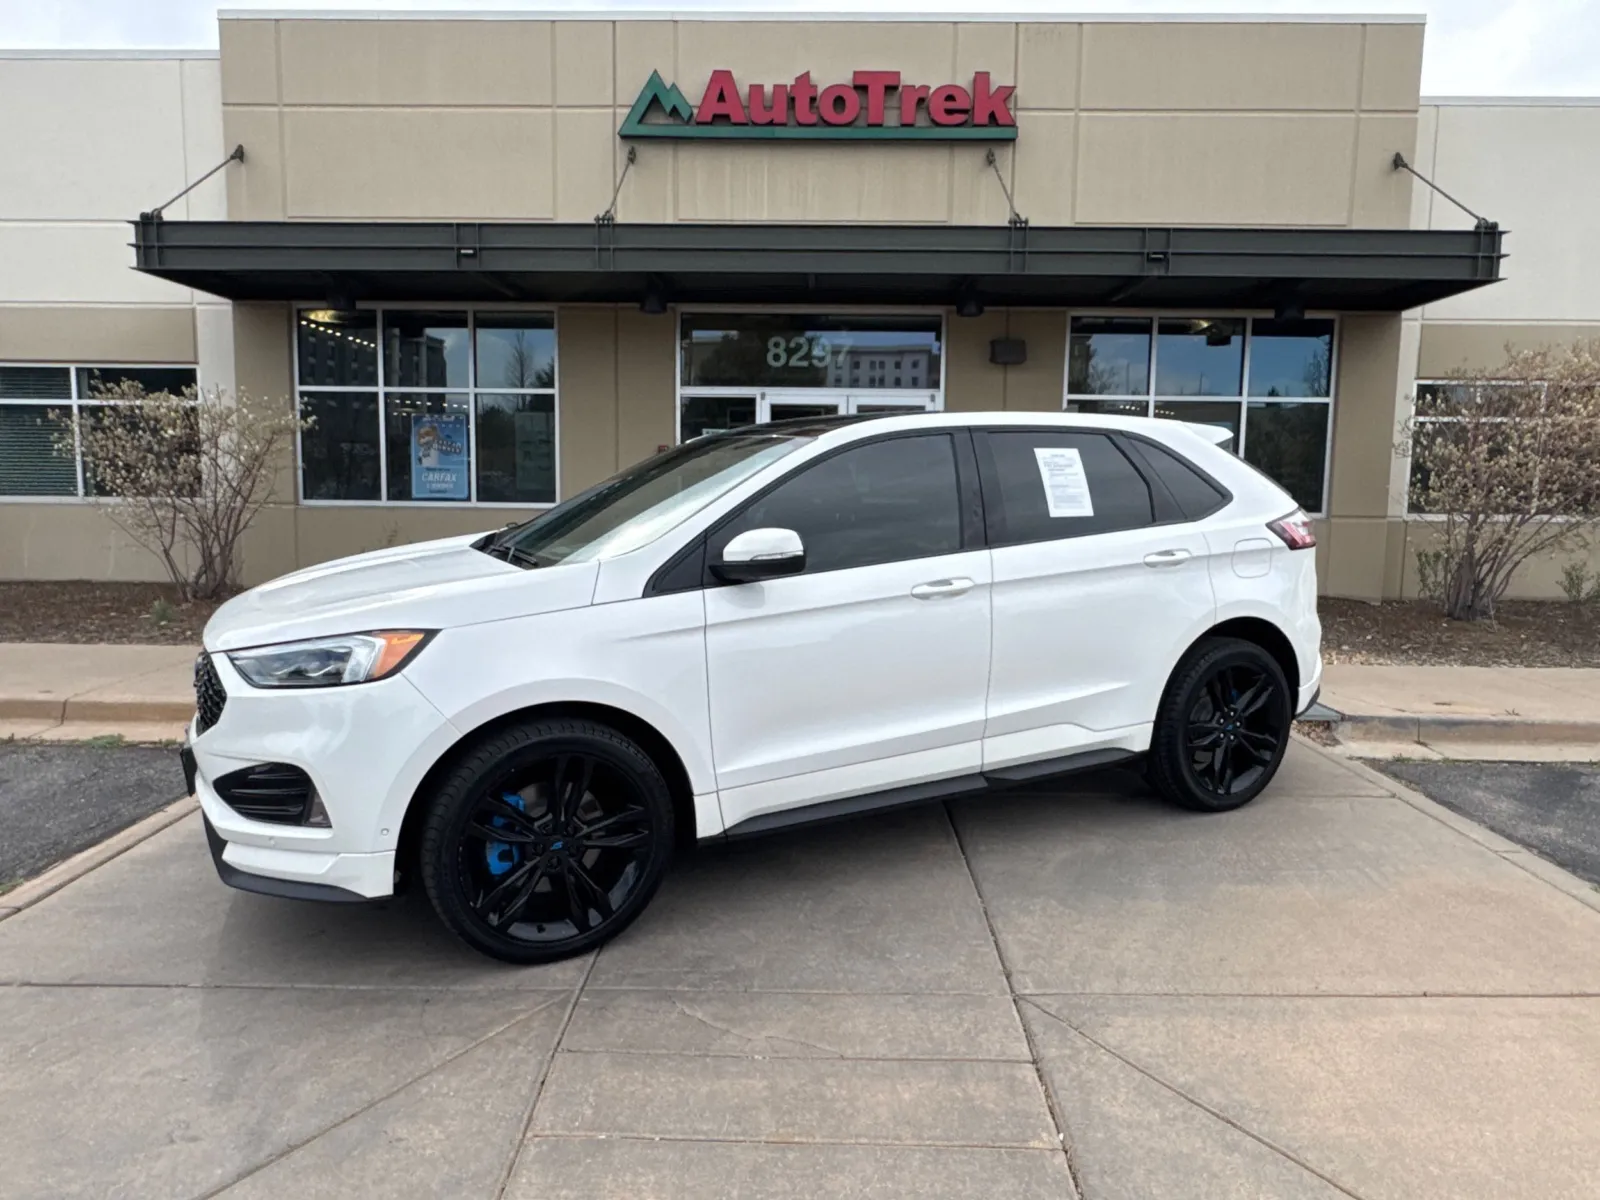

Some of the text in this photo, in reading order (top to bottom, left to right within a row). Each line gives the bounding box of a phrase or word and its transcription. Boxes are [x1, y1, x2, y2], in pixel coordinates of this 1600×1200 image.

[695, 69, 1017, 126] AutoTrek
[766, 335, 853, 368] 8297
[421, 471, 458, 482] CARFAX
